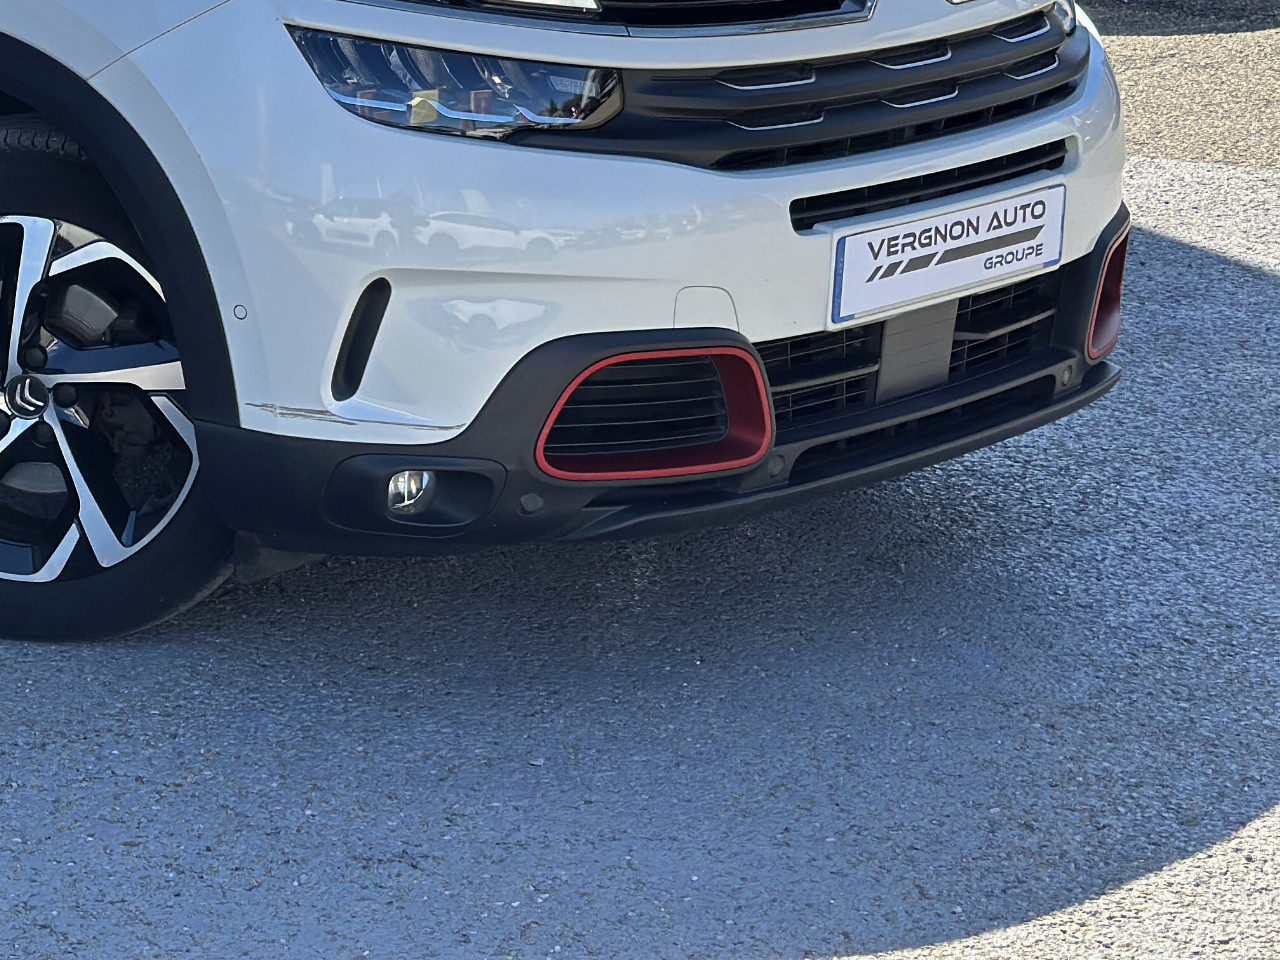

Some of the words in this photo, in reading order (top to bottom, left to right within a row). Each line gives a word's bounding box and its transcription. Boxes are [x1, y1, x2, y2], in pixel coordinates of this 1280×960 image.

[867, 215, 981, 261] VERGNON
[985, 199, 1047, 233] AUTO
[983, 243, 1044, 271] GROUPE
